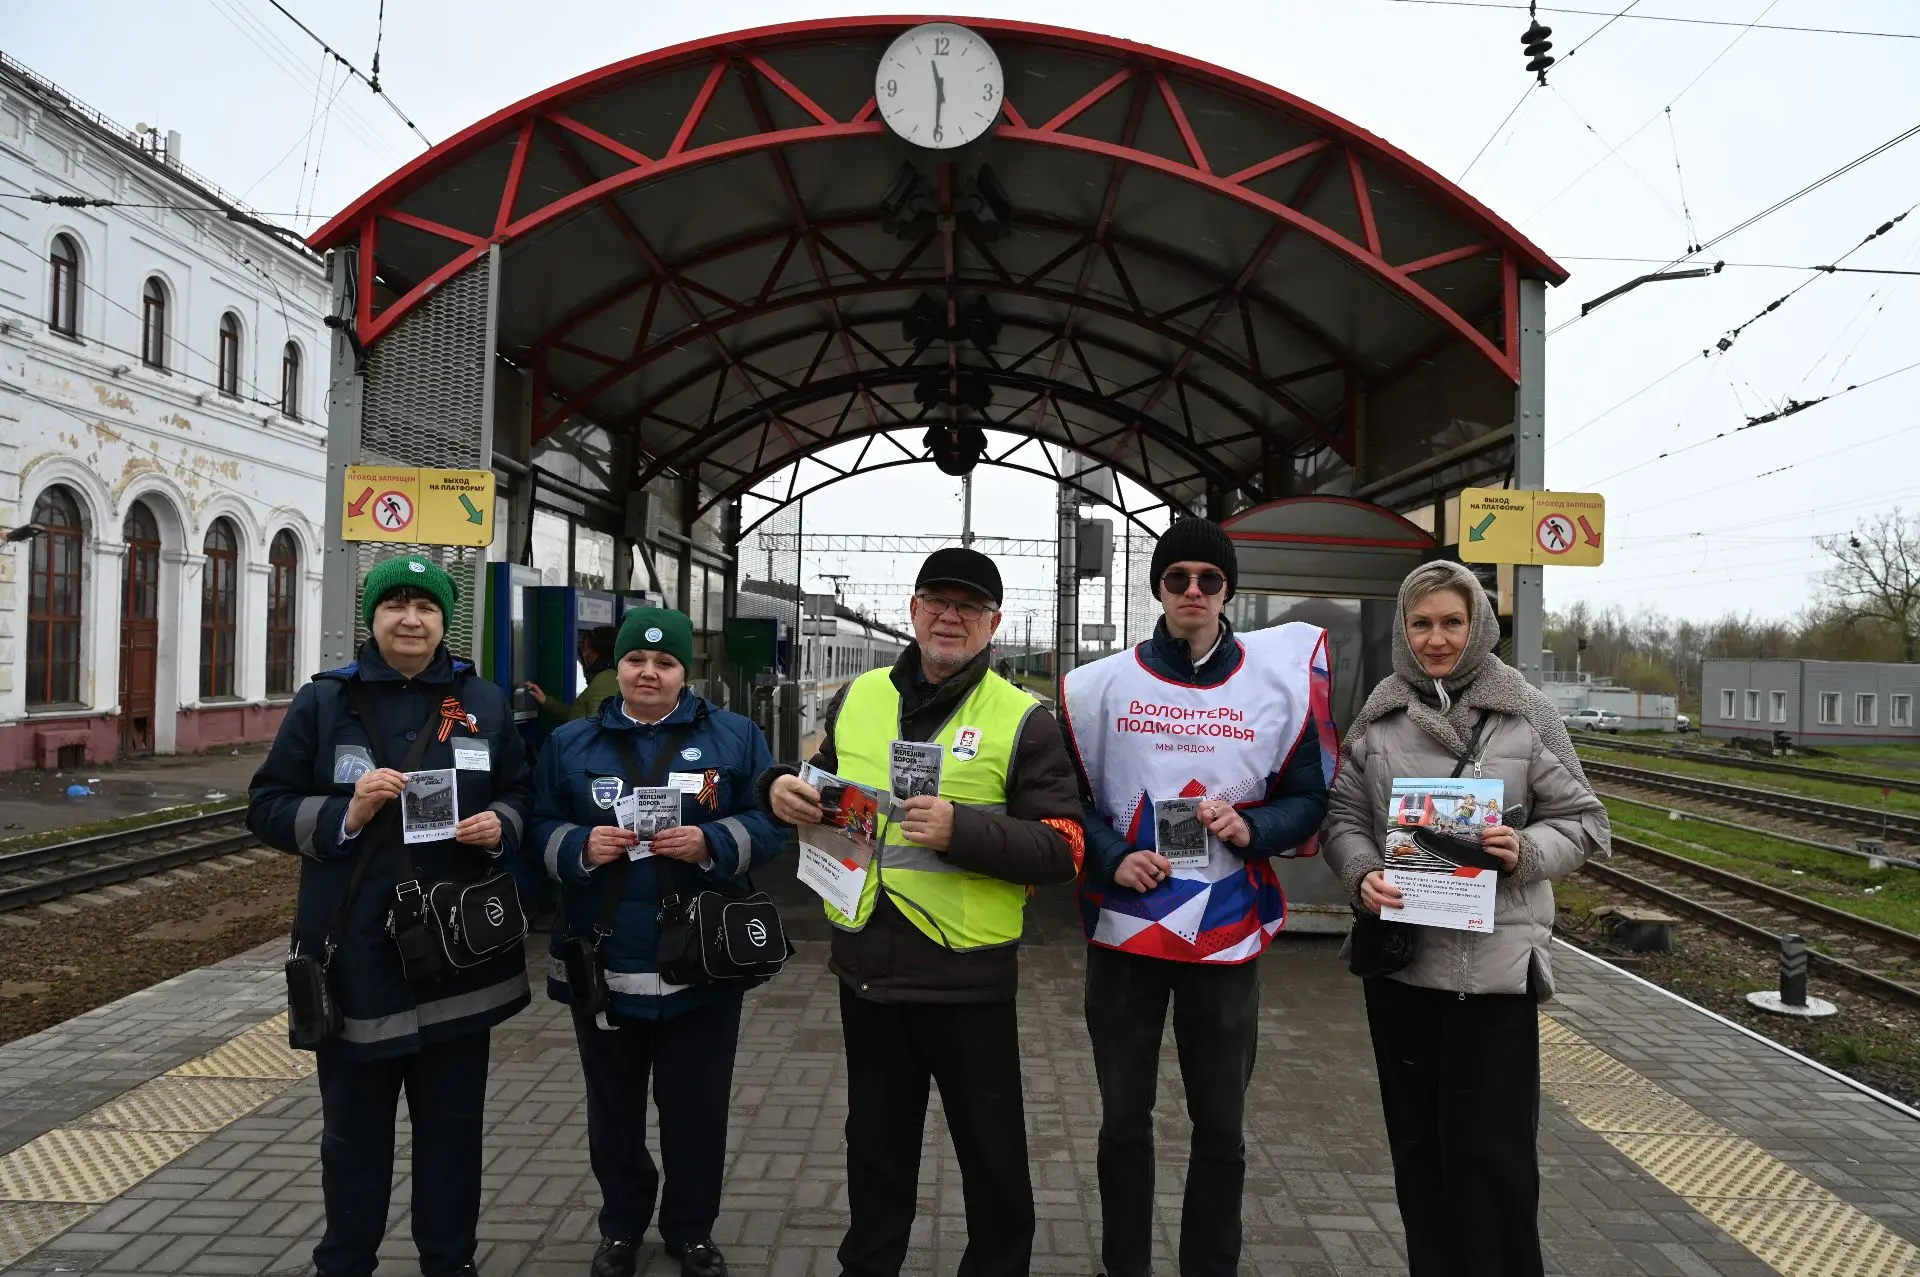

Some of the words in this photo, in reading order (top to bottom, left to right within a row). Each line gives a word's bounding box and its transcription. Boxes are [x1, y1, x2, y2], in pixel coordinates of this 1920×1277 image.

[933, 37, 950, 56] 12
[887, 79, 898, 98] 9
[982, 83, 993, 102] 3
[933, 125, 943, 143] 6
[348, 474, 377, 482] ПРОХОД
[378, 475, 416, 483] ЗАПРЕЩЕН
[443, 477, 470, 485] ВЫХОД
[441, 484, 485, 492] ПЛАТФОРМУ
[1484, 497, 1510, 505] ВЫХОД
[1536, 500, 1565, 509] ПРОХОД
[1566, 501, 1602, 510] ЗАПРЕЩЕН
[1481, 504, 1525, 512] ПЛАТФОРМУ
[1129, 700, 1243, 722] ВОЛОНТЕРЫ
[1117, 717, 1255, 742] ПОДМОСКОВЬЯ
[1155, 743, 1174, 752] МЫ
[1177, 744, 1215, 754] РЯДОМ
